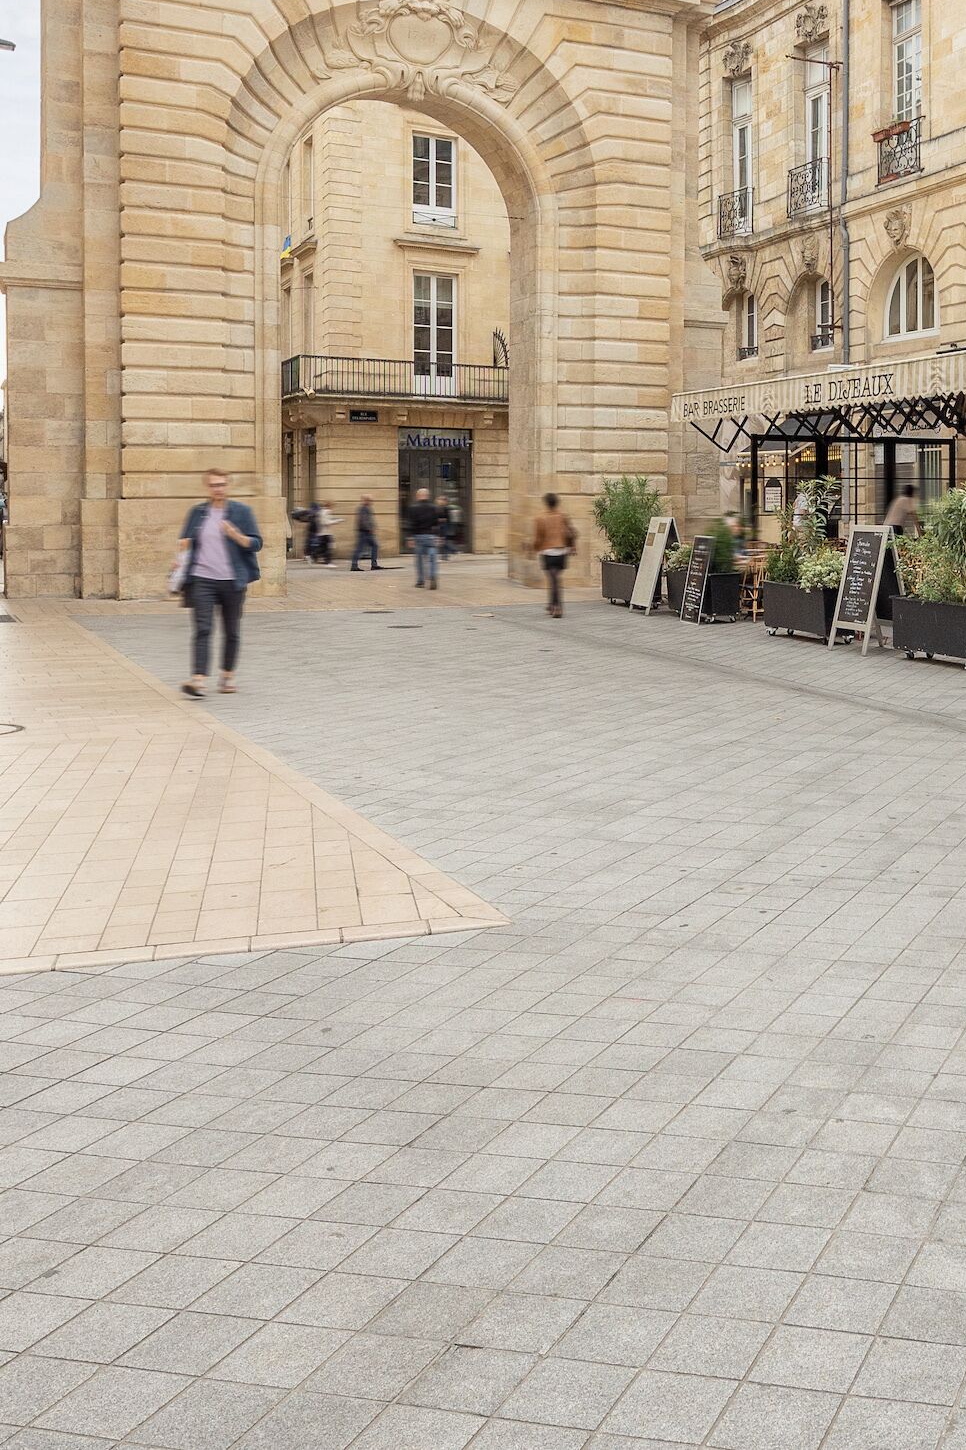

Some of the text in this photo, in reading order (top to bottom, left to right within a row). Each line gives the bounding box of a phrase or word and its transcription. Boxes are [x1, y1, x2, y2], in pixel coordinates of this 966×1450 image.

[804, 373, 894, 404] LE DIJEAUX
[683, 396, 746, 418] BAR BRASSERIE
[406, 434, 469, 448] Matmut
